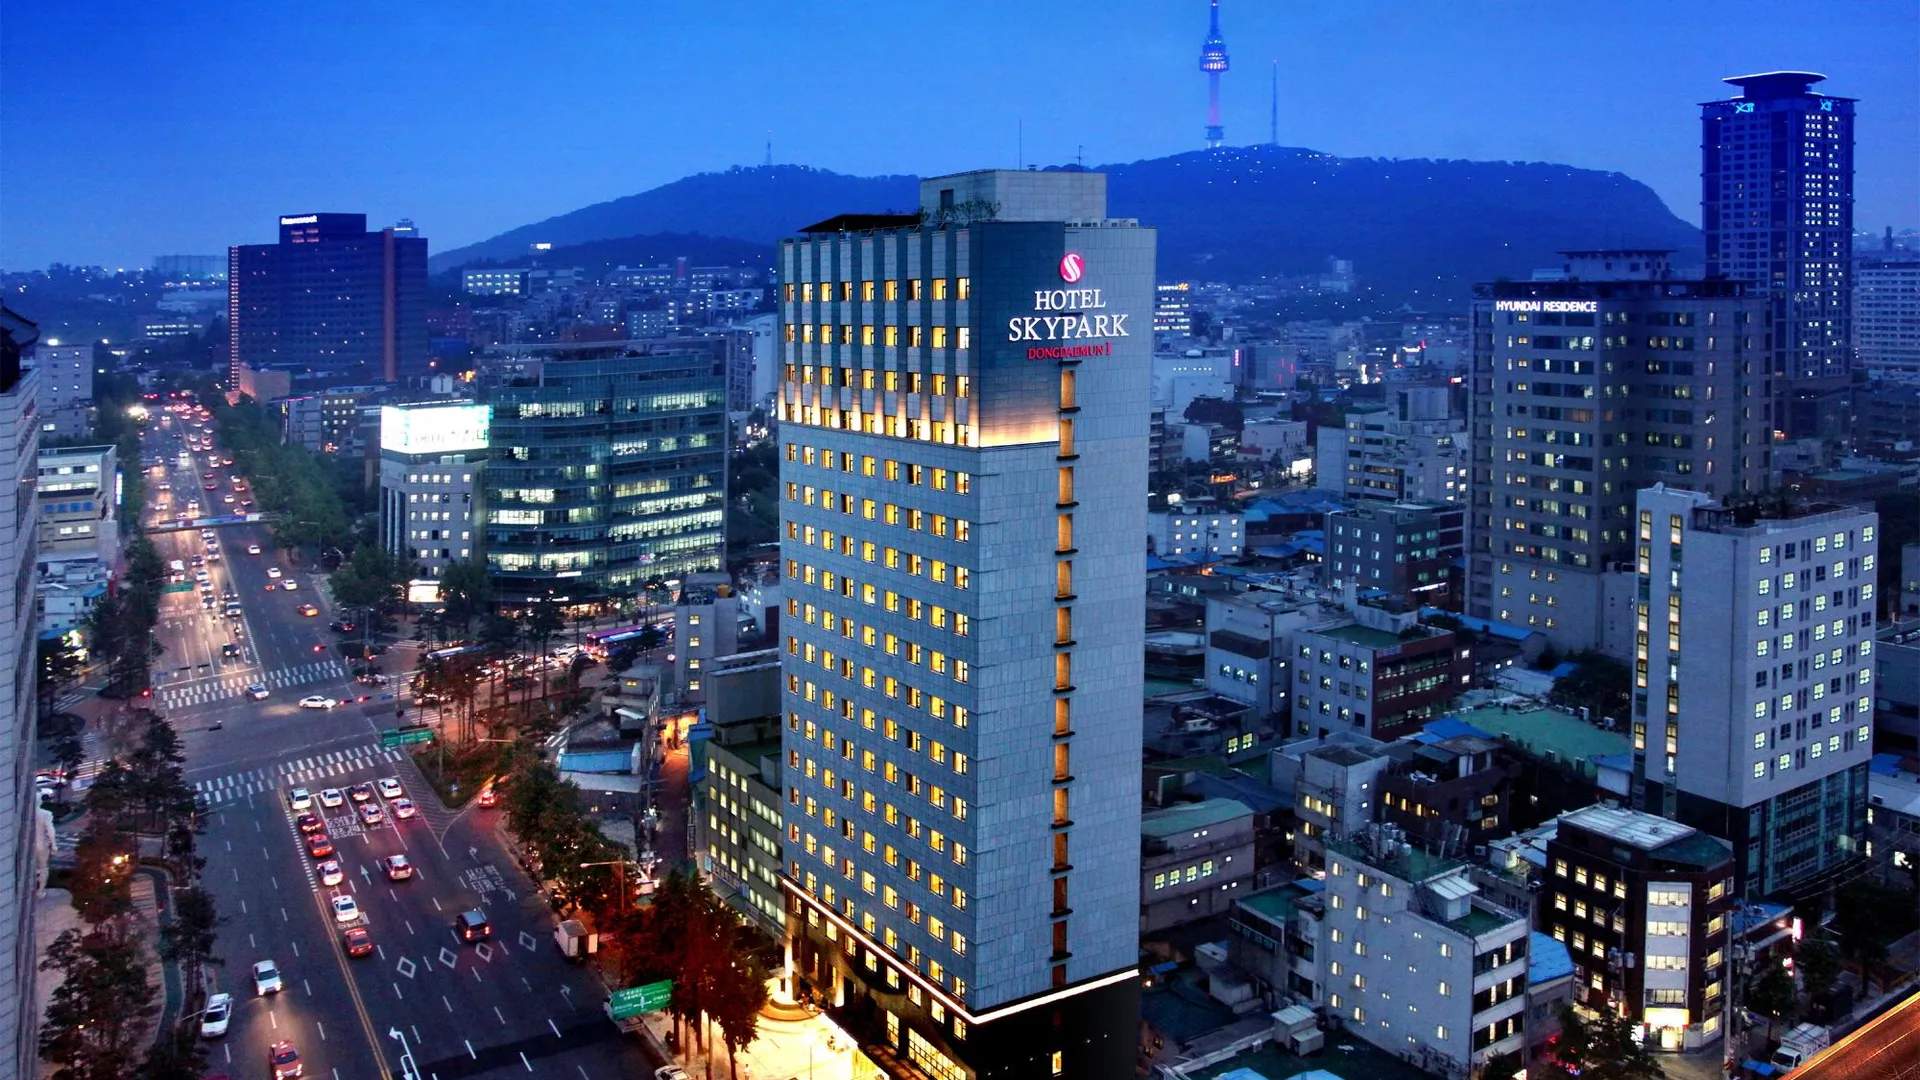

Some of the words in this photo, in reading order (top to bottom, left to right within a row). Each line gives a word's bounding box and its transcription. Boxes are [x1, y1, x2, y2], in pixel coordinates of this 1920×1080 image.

[1034, 289, 1106, 310] HOTEL
[1496, 301, 1541, 311] HYUNDAI
[1543, 301, 1597, 312] RESIDENCE
[1008, 314, 1130, 341] SKYPARK
[1028, 345, 1104, 360] DONGDAEMUN
